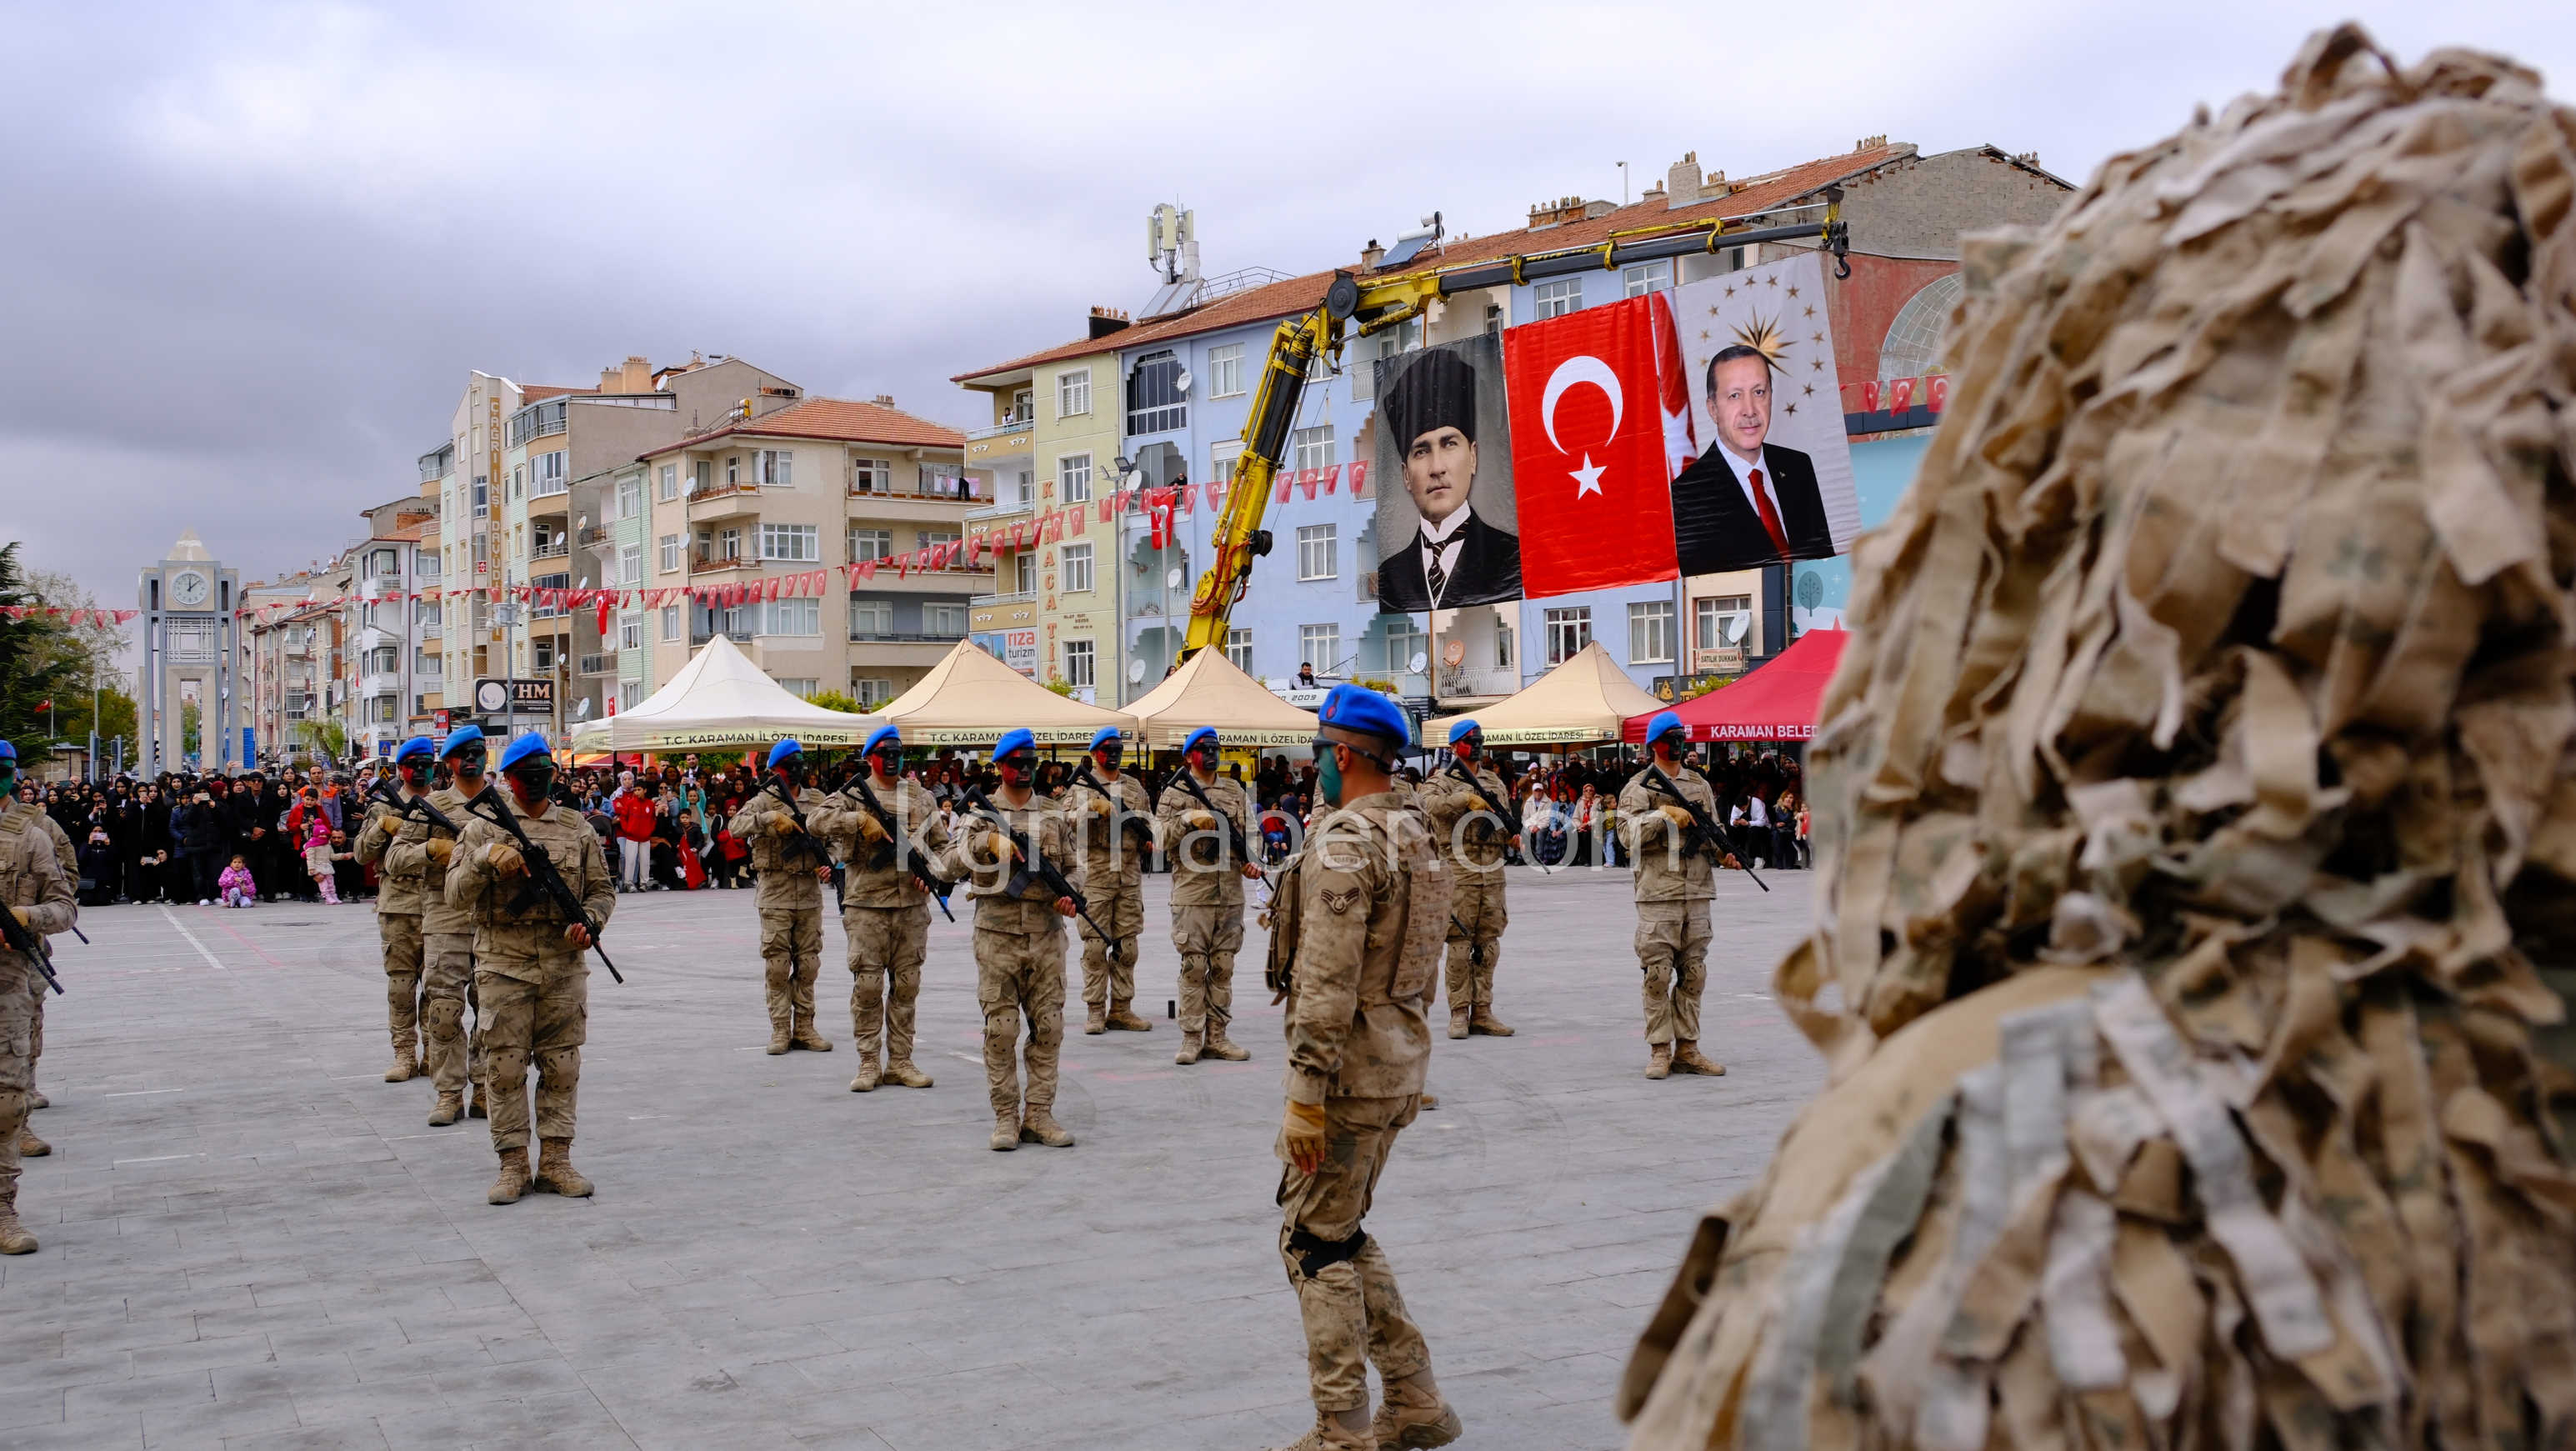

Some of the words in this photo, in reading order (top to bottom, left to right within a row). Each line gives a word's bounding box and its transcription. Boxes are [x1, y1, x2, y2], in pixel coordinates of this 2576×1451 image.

[1042, 481, 1057, 610] KABACA
[1008, 648, 1035, 658] turizm
[930, 733, 950, 742] T.C.
[953, 732, 1002, 742] KARAMA
[1057, 729, 1096, 741] İDARES
[1483, 733, 1513, 743] AMAN
[1515, 731, 1523, 741] İL
[1525, 731, 1547, 741] ÖZEL
[1711, 726, 1774, 738] KARAMAN
[1777, 725, 1820, 738] BELED
[663, 737, 686, 745] T.C.
[688, 733, 754, 744] KARAMAN
[759, 733, 770, 742] İL
[1218, 734, 1257, 743] RAMAN
[1261, 733, 1268, 743] İL
[1271, 733, 1294, 744] ÖZEL
[1298, 733, 1314, 744] İDA
